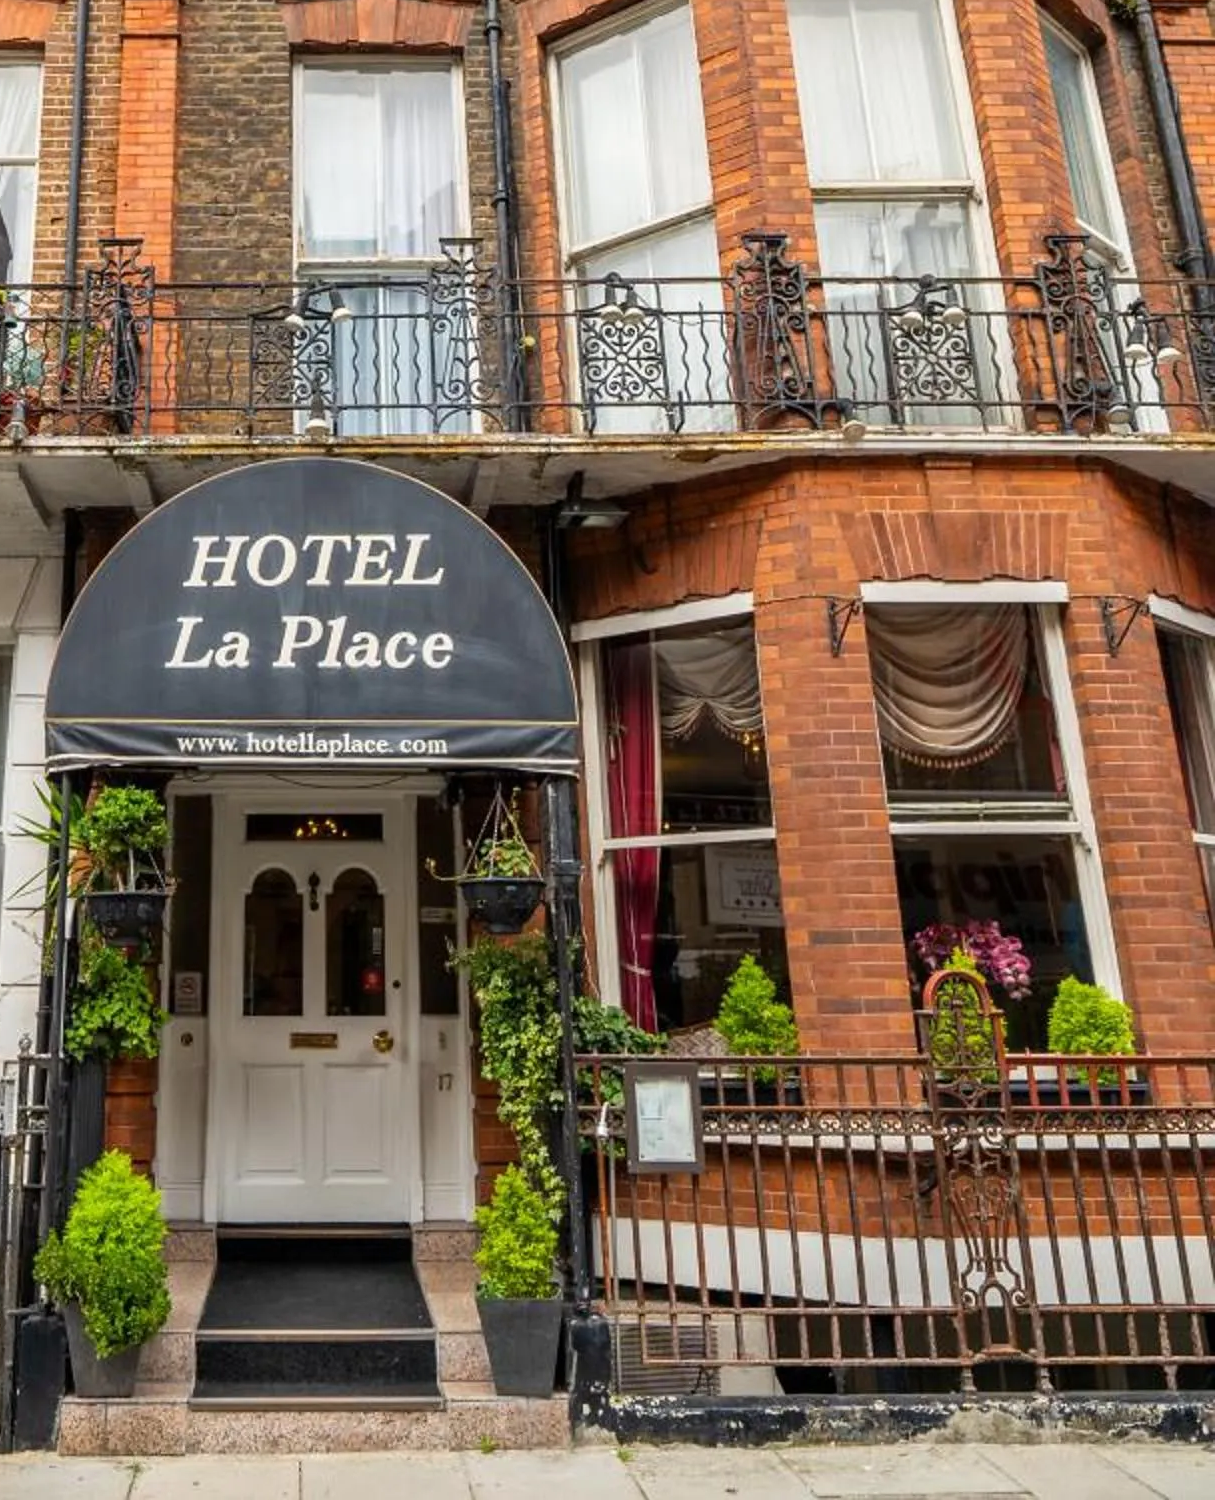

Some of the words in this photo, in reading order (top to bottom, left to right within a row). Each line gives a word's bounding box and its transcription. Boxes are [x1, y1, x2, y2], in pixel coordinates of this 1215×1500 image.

[182, 533, 443, 587] HOTEL
[165, 616, 250, 669] La
[272, 614, 454, 669] Place
[437, 1072, 454, 1091] 17
